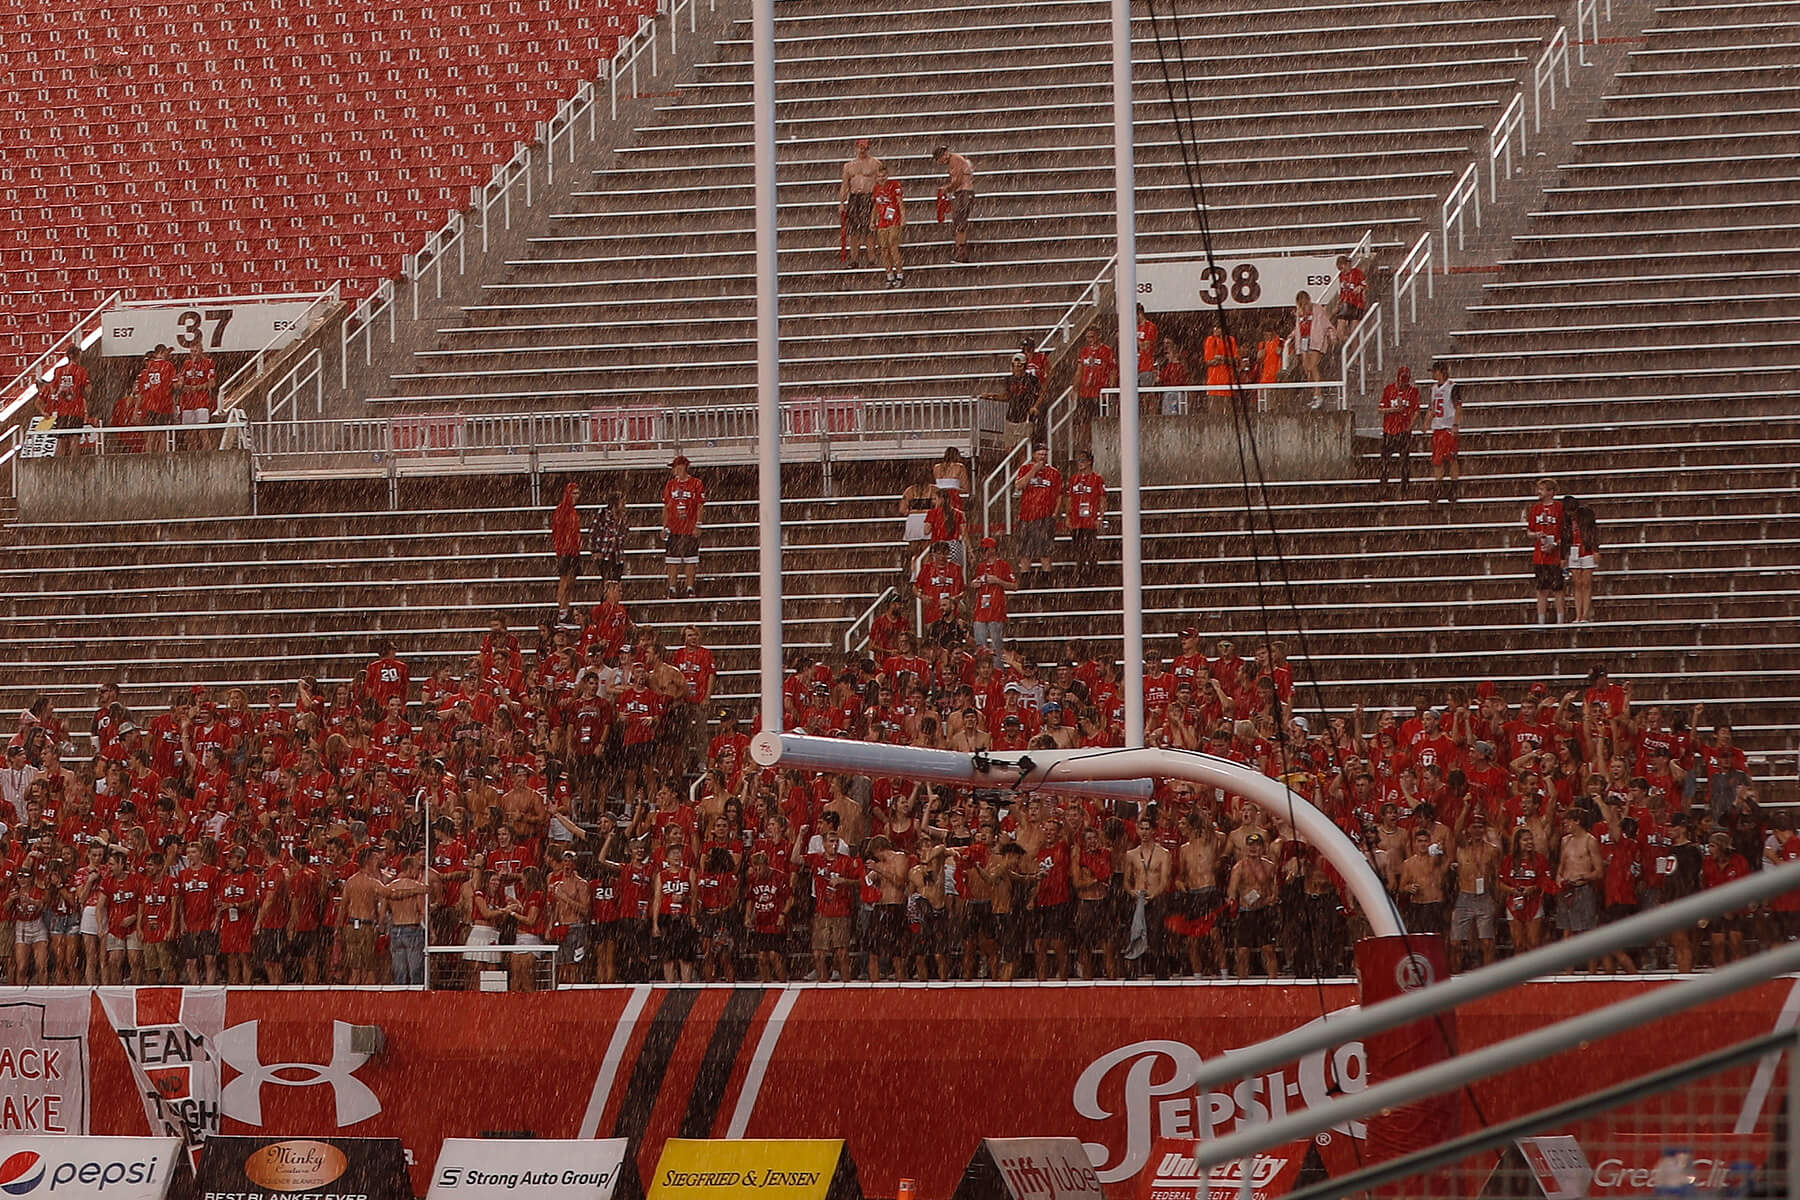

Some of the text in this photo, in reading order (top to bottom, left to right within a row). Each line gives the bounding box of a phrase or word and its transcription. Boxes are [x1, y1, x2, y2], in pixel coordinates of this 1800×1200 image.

[1136, 283, 1153, 293] 38
[1199, 263, 1261, 305] 38
[1307, 275, 1331, 286] E39
[113, 327, 135, 338] E37
[176, 309, 234, 348] 37
[381, 668, 399, 682] 20
[118, 1029, 211, 1064] TEAM
[267, 1145, 323, 1173] Minky
[49, 1156, 158, 1191] pepsi
[466, 1170, 517, 1189] Strong
[520, 1170, 557, 1186] Auto
[662, 1170, 821, 1189] SIEGFRIED & JENSEN
[204, 1192, 246, 1200] BEST
[1151, 1191, 1191, 1200] FEDERAL
[1195, 1191, 1230, 1200] CEDIT
